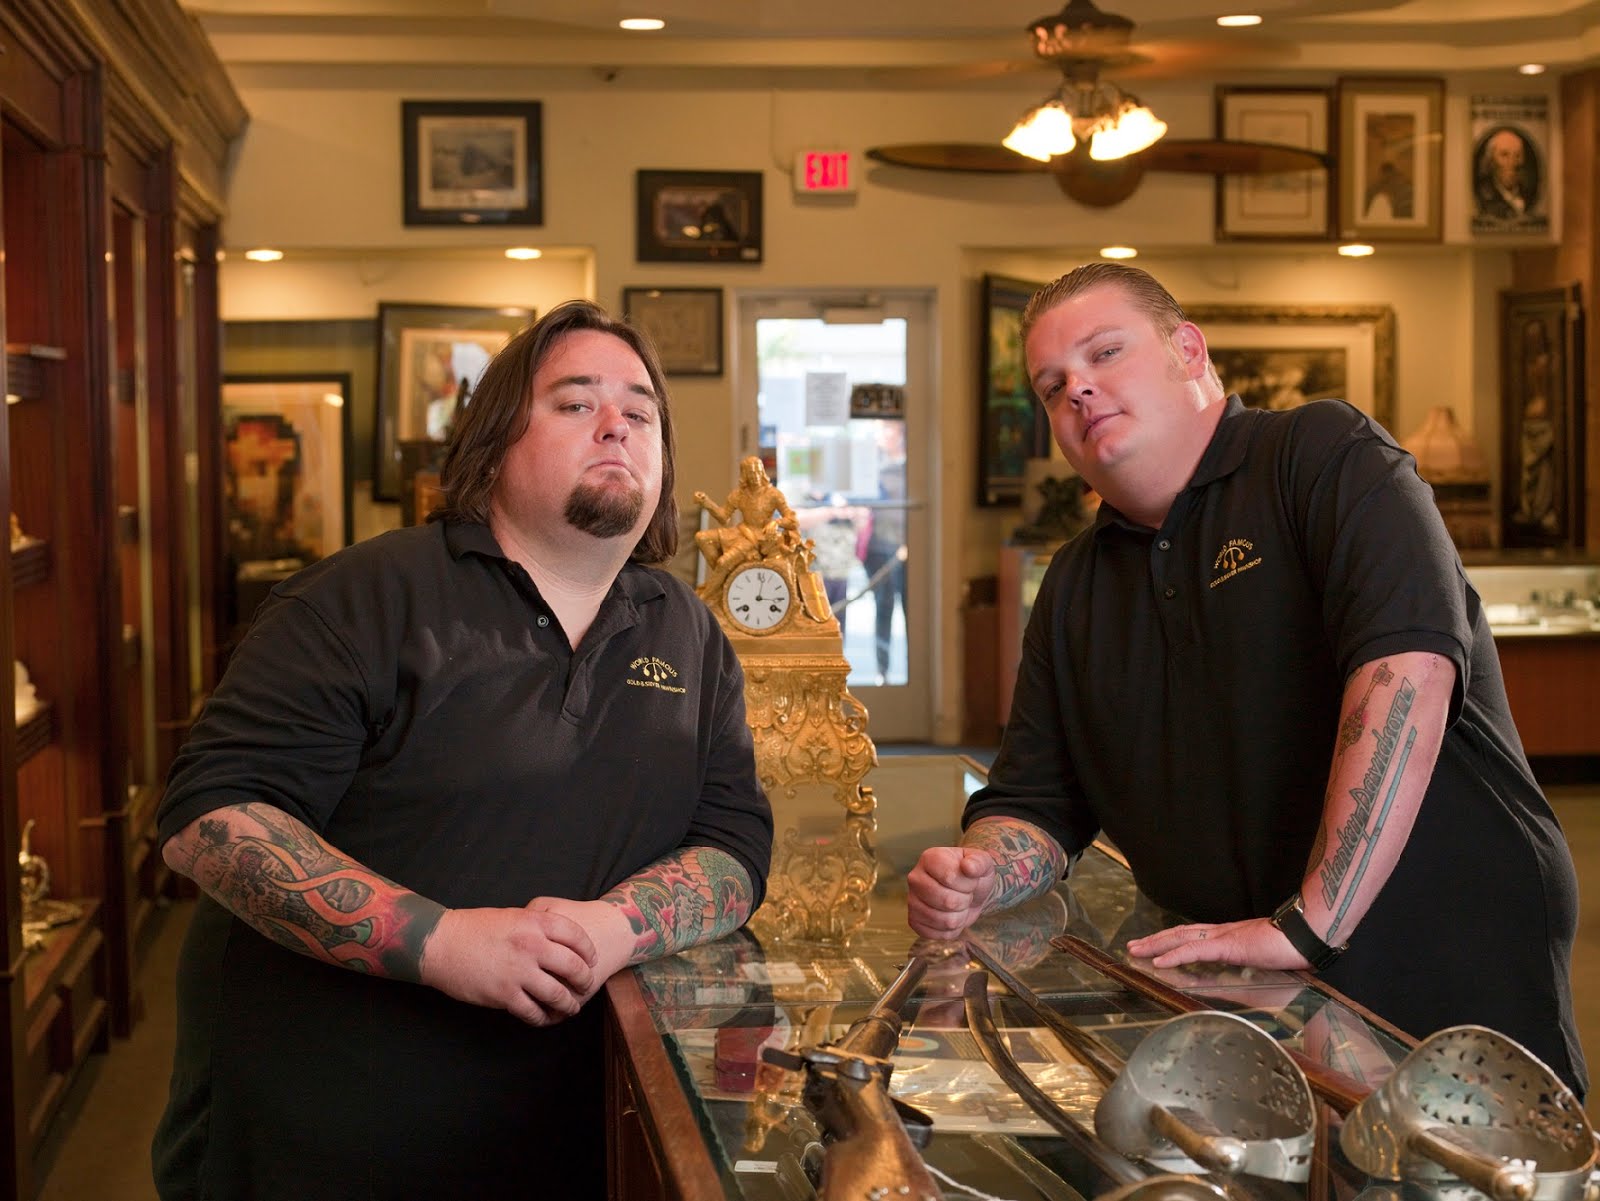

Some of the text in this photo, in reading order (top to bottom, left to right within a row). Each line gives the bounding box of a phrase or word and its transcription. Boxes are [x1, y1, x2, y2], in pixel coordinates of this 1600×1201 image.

[805, 152, 849, 190] EXIT
[1228, 538, 1253, 551] FAMOUS
[629, 656, 678, 678] WORLD FAMOUS
